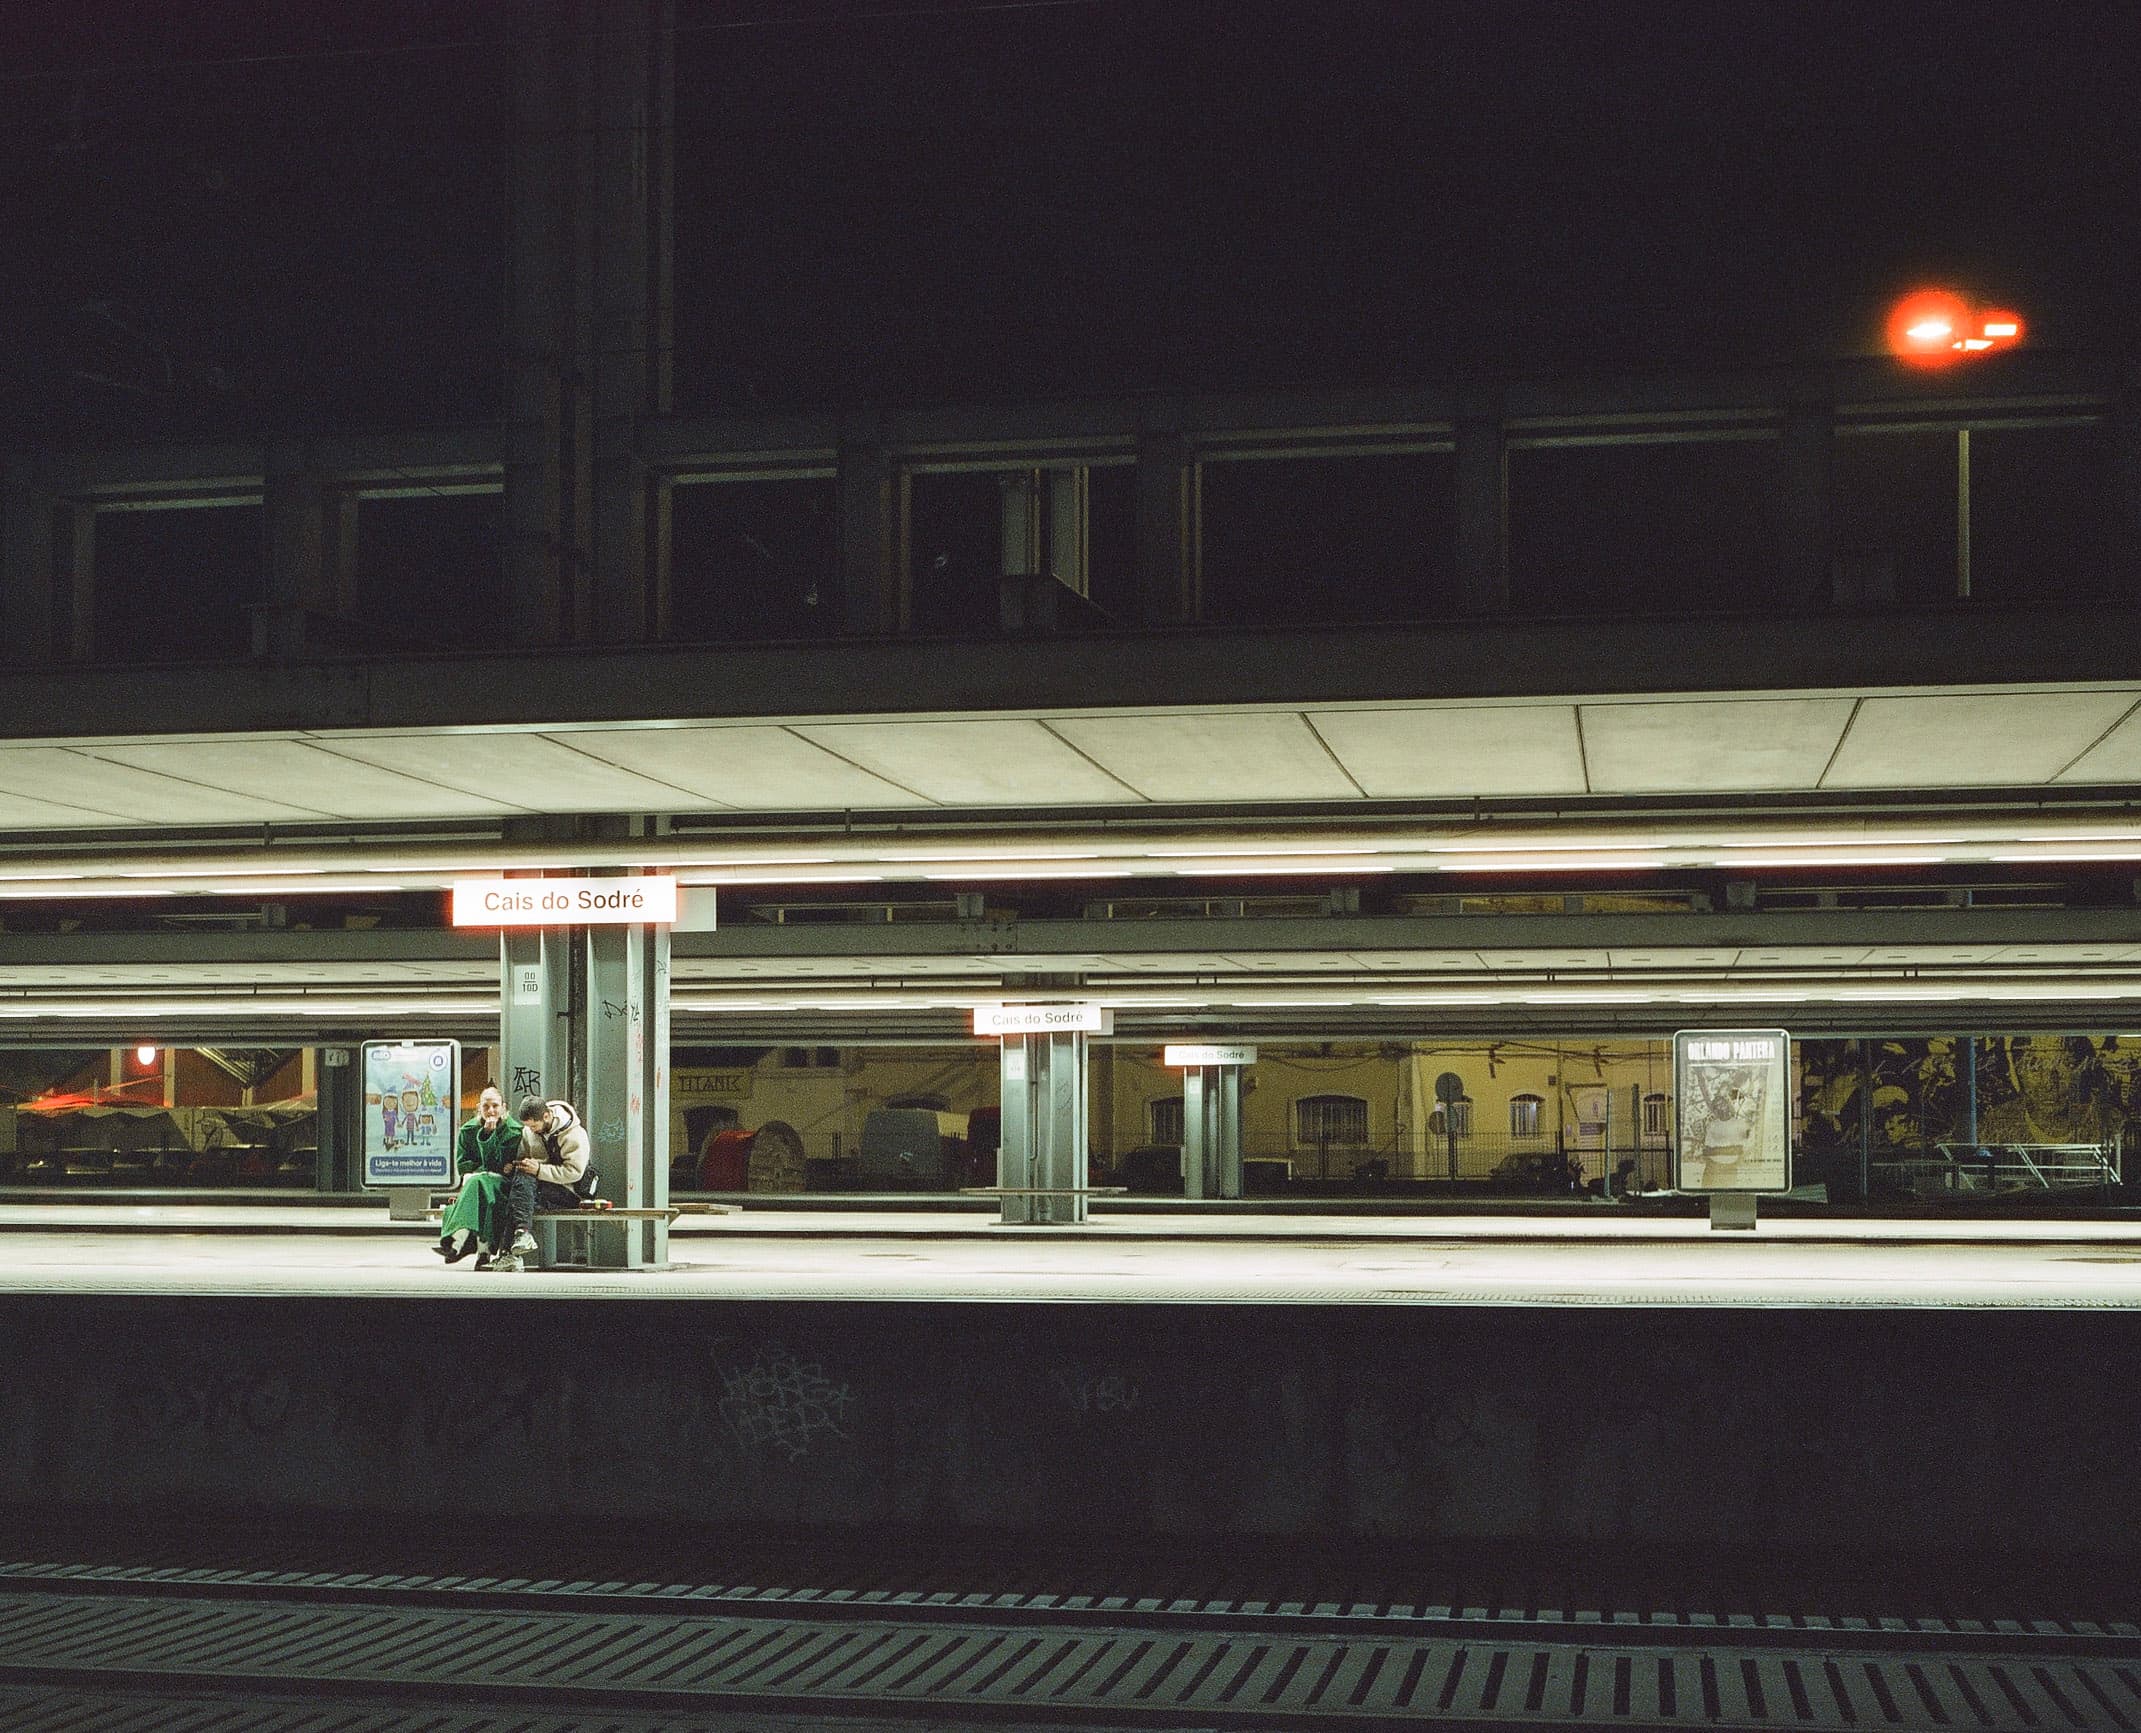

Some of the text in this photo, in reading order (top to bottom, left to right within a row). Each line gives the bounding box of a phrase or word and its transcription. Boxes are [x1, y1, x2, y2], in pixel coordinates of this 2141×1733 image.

[484, 888, 644, 911] Cais do Sodré
[992, 1005, 1084, 1026] Cais do Sodré
[1733, 1040, 1776, 1060] PANTERA
